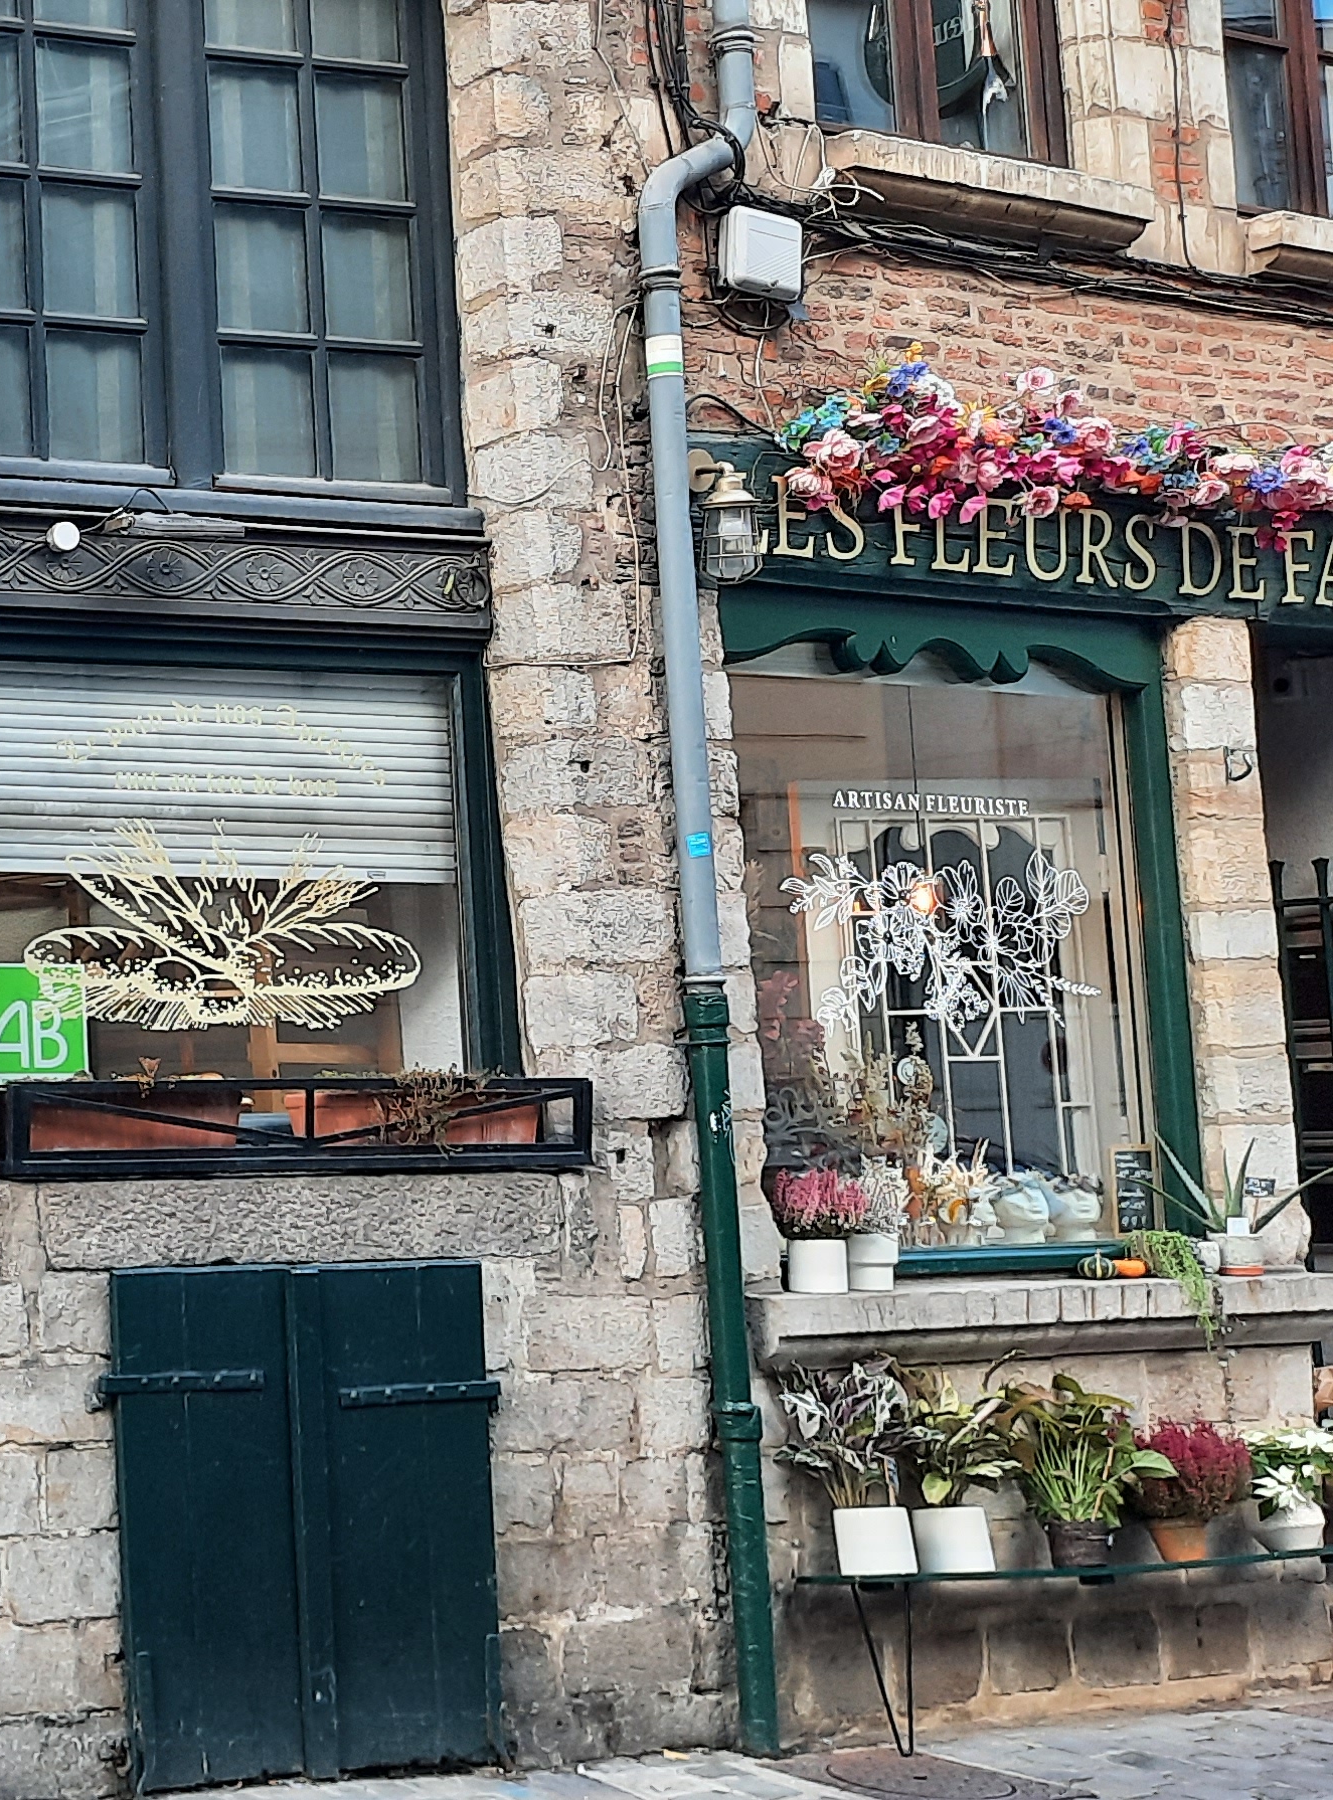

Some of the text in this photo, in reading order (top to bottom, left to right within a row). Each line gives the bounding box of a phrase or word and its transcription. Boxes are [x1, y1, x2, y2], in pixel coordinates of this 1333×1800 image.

[737, 472, 865, 560] ES
[890, 497, 1157, 591] FLEURS
[1179, 521, 1266, 601] DE
[106, 713, 163, 748] pain
[171, 700, 203, 725] de
[214, 702, 265, 727] nos
[833, 790, 1030, 817] ARTISAN FLEURISTE
